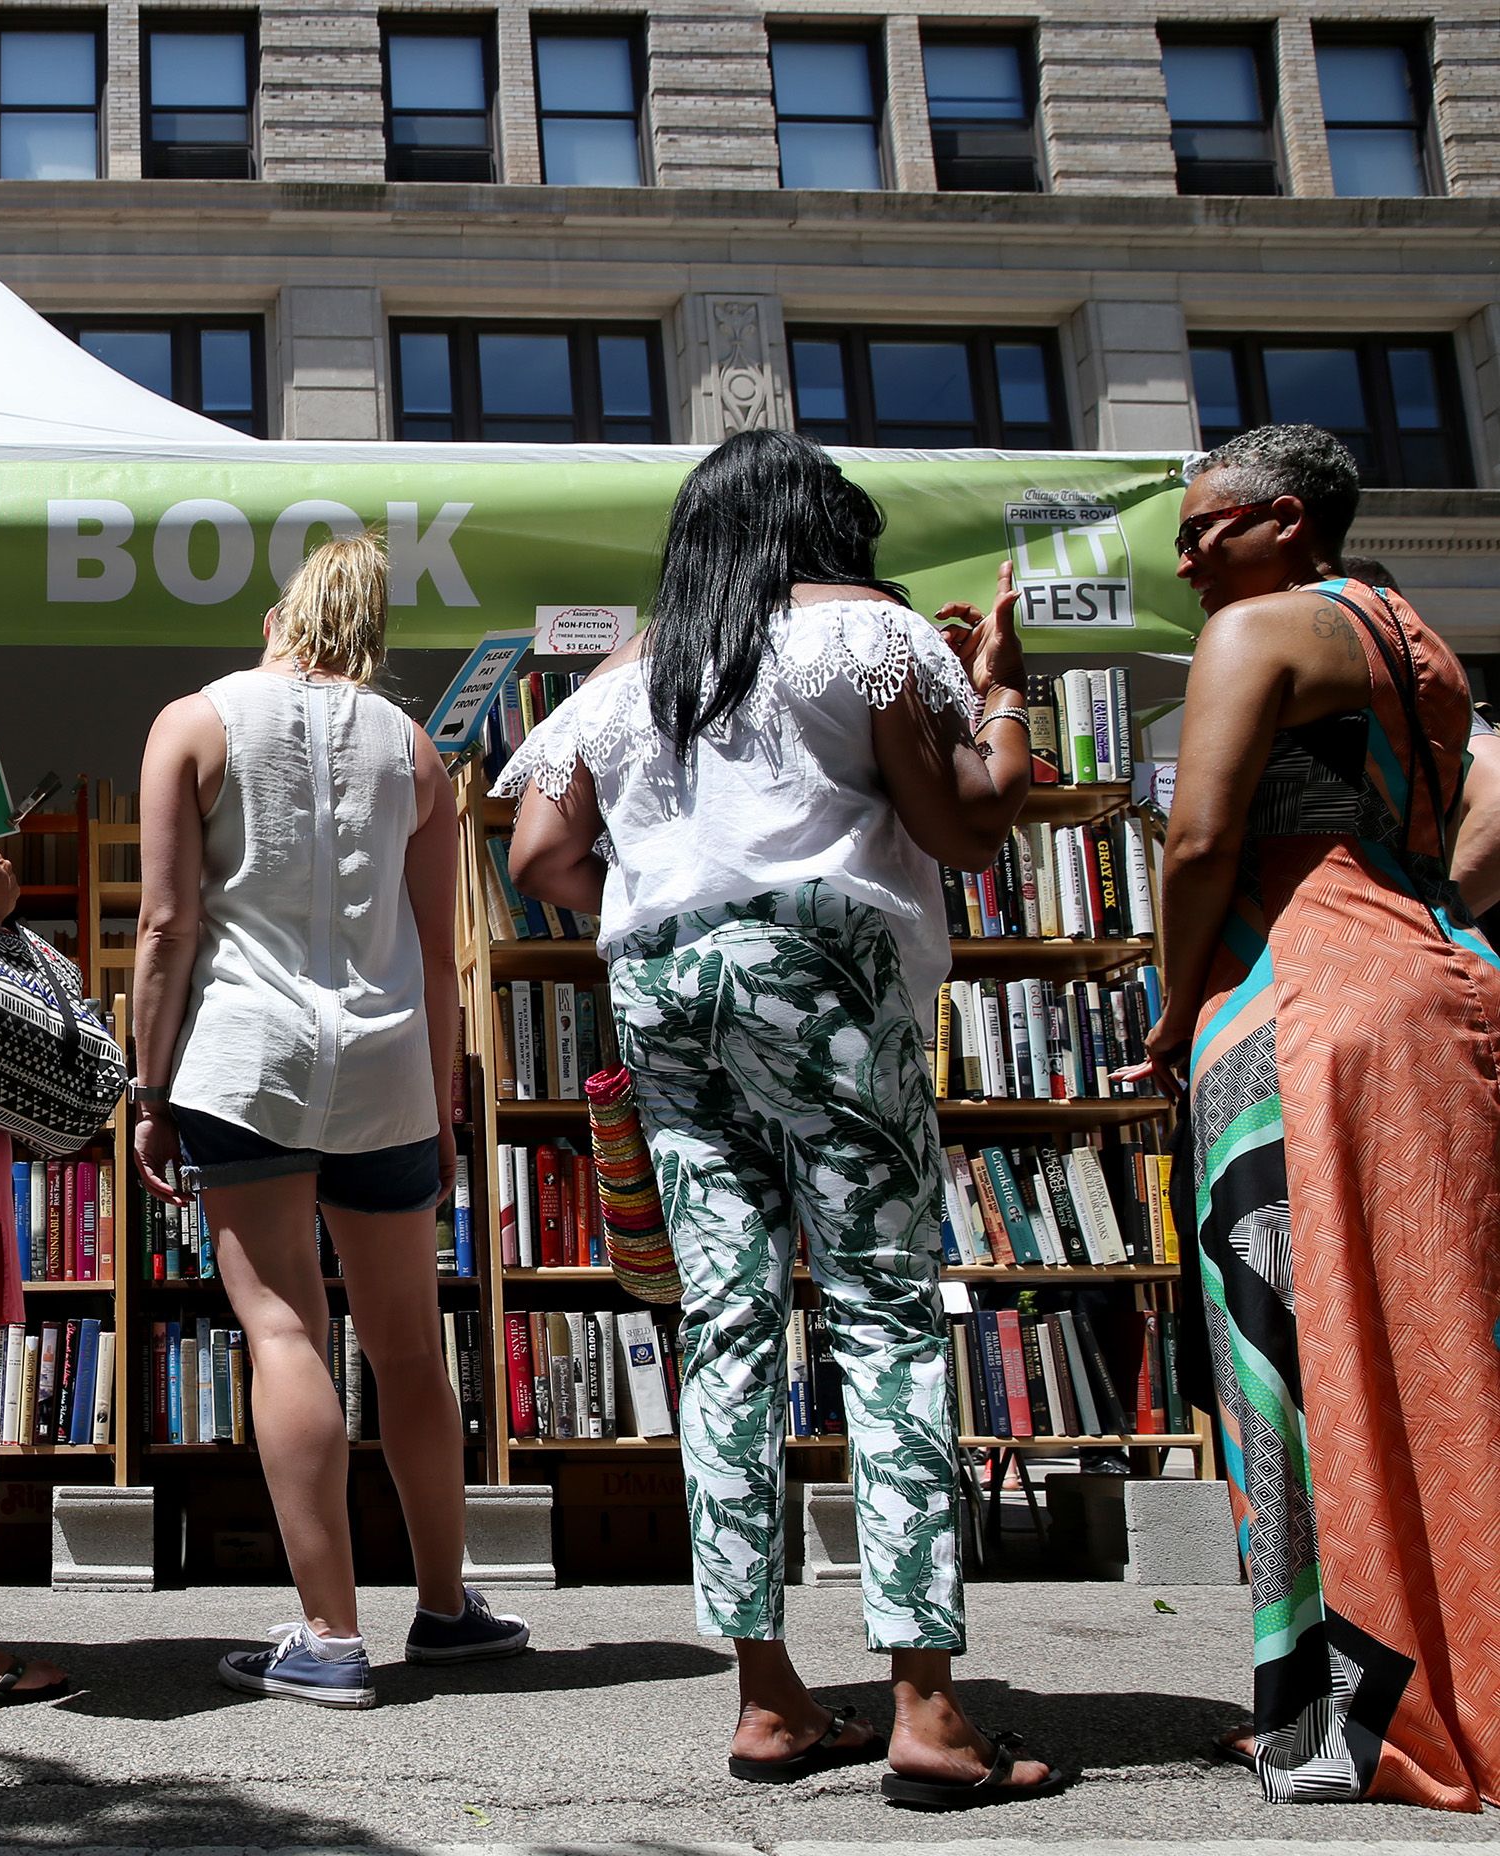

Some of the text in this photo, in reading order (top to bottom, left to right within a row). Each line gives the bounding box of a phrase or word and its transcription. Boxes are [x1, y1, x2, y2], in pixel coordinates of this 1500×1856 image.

[1024, 489, 1098, 502] Chicago Tribune
[1010, 508, 1112, 521] PRINTERS ROW
[1013, 525, 1118, 578] LIT
[1023, 583, 1127, 622] FEST
[558, 621, 613, 630] NON-FICTION
[482, 650, 514, 662] PLEASE
[566, 643, 601, 651] $3 EACH
[460, 682, 493, 694] AROUND
[478, 667, 497, 677] PAY
[453, 698, 482, 710] FRONT
[1004, 862, 1014, 892] ROMNEY
[1097, 840, 1117, 909] GRAY FOX
[1132, 833, 1150, 906] CHRIST
[940, 988, 950, 1052] NO WAY DOWN
[1030, 984, 1044, 1020] GOLF
[561, 1038, 572, 1079] Paul Simon
[990, 1150, 1014, 1204] Cronkite
[83, 1200, 95, 1257] TIMOTHY LEARY
[509, 1319, 521, 1360] CHANG
[519, 1326, 529, 1355] IRIS
[984, 1331, 997, 1367] CHARLIES
[1029, 1325, 1038, 1344] THE
[460, 1351, 472, 1403] MIDDLE AGES
[587, 1320, 599, 1398] ROGUE STATE
[26, 1374, 35, 1394] 1940
